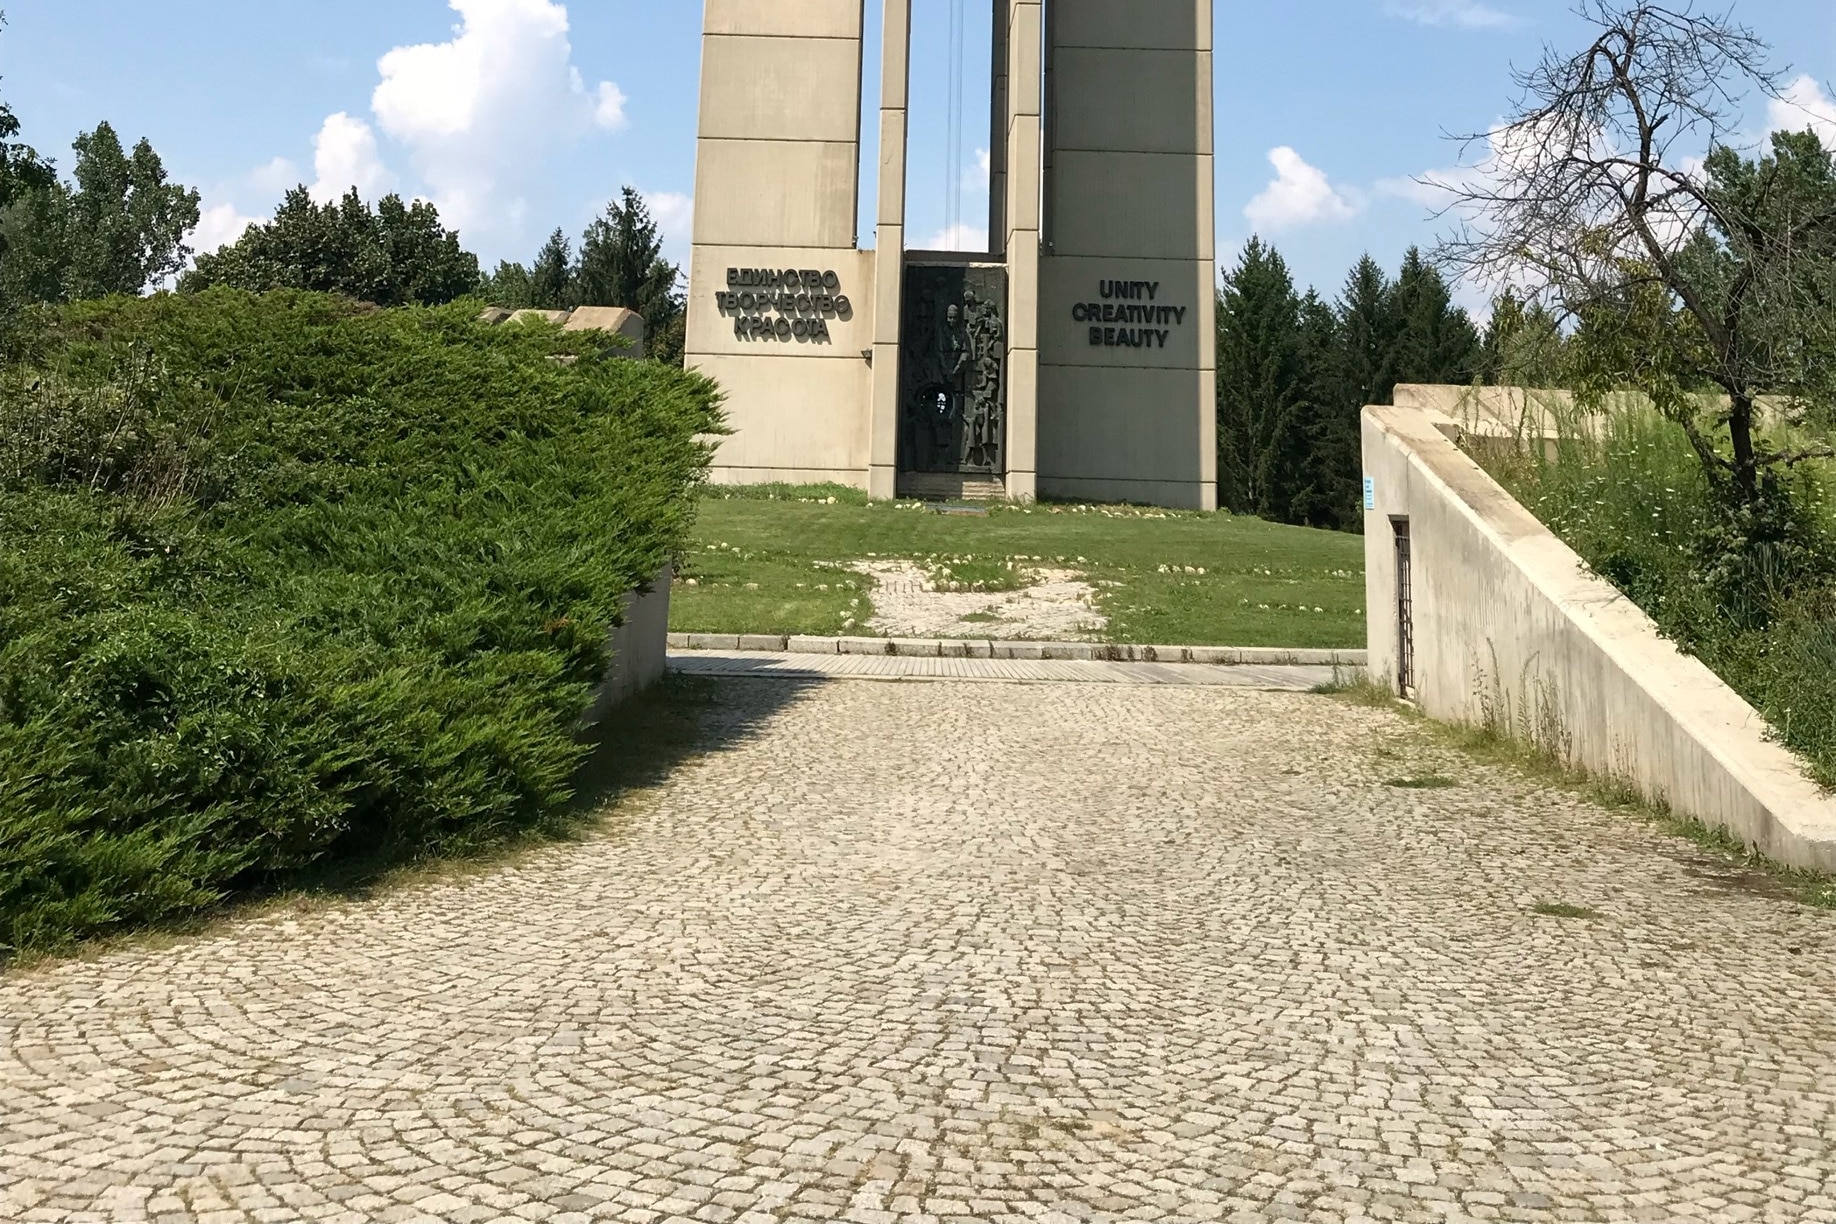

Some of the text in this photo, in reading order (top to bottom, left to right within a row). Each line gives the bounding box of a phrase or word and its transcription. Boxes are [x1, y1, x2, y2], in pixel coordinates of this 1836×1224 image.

[727, 267, 839, 289] ЕДИНСТВО
[1099, 279, 1159, 301] UNITY
[715, 291, 851, 314] ТВОРЧЕСТВО
[1072, 302, 1187, 325] CREATIVITY
[733, 315, 830, 337] КРАСОТА
[1089, 326, 1170, 349] BEAUTY
